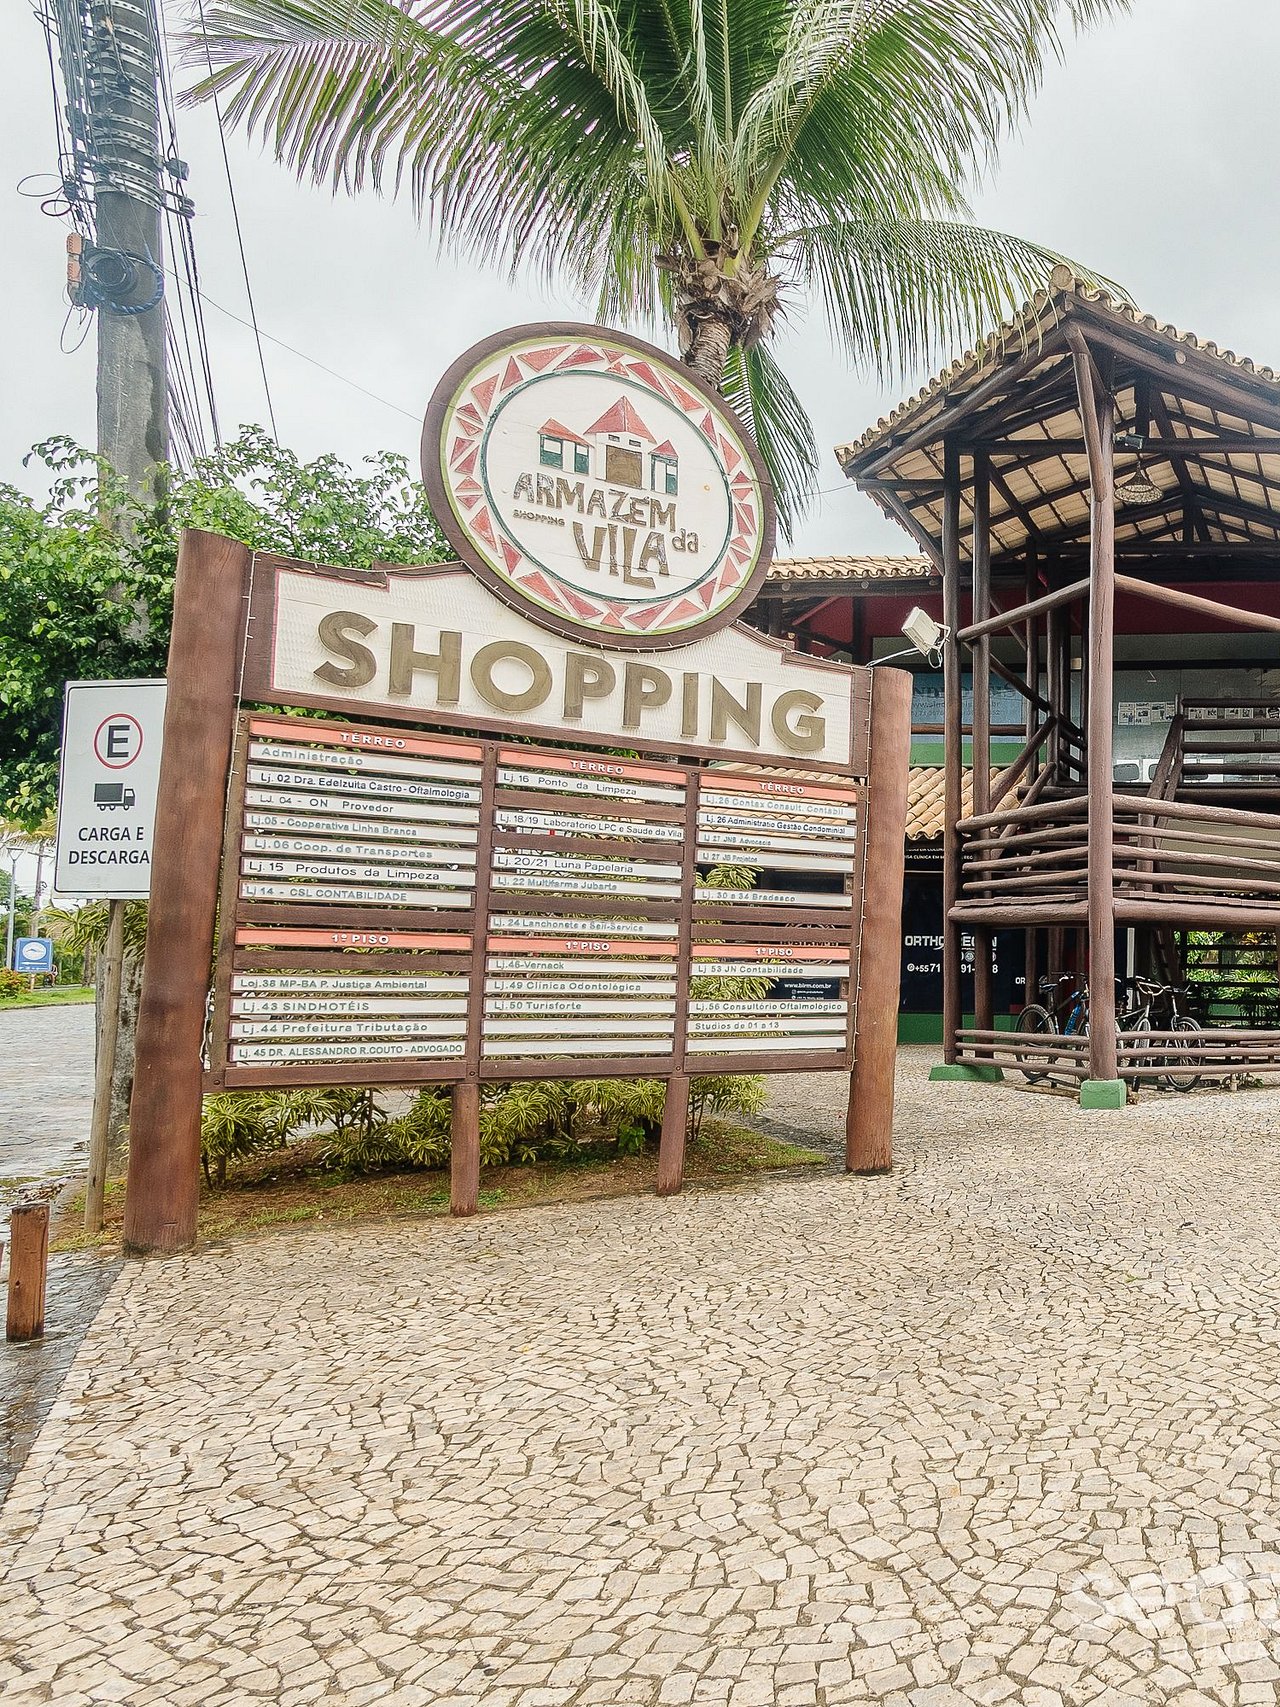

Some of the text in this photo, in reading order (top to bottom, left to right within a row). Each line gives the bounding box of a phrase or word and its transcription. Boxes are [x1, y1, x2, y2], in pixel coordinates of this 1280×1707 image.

[513, 509, 565, 527] SHOPPING
[672, 528, 699, 553] da
[573, 521, 670, 589] VILA
[313, 610, 826, 753] SHOPPING
[107, 724, 130, 758] E
[341, 731, 406, 748] TÉRREO
[261, 747, 363, 767] Administração
[261, 773, 273, 784] Lj.
[277, 774, 290, 784] 02
[294, 775, 316, 786] Dra.
[503, 773, 517, 784] Lj.
[538, 776, 568, 788] Ponto
[576, 781, 589, 790] da
[596, 784, 637, 796] Limpeza
[279, 796, 292, 805] 04
[310, 798, 328, 808] ON
[342, 801, 394, 814] Provedor
[287, 818, 349, 832] Cooperativa
[353, 823, 379, 834] Linha
[382, 826, 417, 836] Branca
[500, 814, 512, 824] Lj.
[514, 815, 539, 825] 18/19
[599, 822, 617, 832] LPC
[655, 828, 666, 837] da
[667, 829, 683, 839] Vila
[717, 816, 727, 824] 26
[803, 824, 846, 835] Condominial
[78, 827, 144, 842] CARGA E
[68, 851, 150, 865] DESCARGA
[293, 841, 332, 853] Coop.
[336, 844, 352, 854] de
[356, 845, 433, 860] Transportes
[249, 861, 440, 882] Lj. 15 Produtos da Limpeza
[497, 855, 634, 874] Lj. 20/21 Luna Papelaria
[527, 879, 579, 890] Multifarma
[261, 887, 274, 896] 14
[290, 888, 313, 898] CSL
[316, 889, 408, 902] CONTABILIDADE
[752, 893, 796, 902] Bradesco
[508, 919, 520, 927] 24
[522, 919, 579, 930] Lanchonete
[351, 934, 390, 945] PISO
[581, 941, 610, 951] PISO
[768, 948, 793, 957] PISO
[711, 966, 722, 974] 53
[724, 966, 736, 974] JN
[739, 966, 804, 975] Contabilidade
[279, 979, 317, 989] MP-BA
[320, 980, 329, 989] P.
[332, 980, 372, 991] Justiça
[374, 980, 427, 989] Ambiental
[282, 1001, 370, 1012] SINDHOTÉIS
[526, 1001, 582, 1010] Turisforte
[282, 1023, 352, 1033] Prefeitura
[356, 1022, 428, 1034] Tributação
[695, 1022, 731, 1031] Studios
[734, 1022, 745, 1030] de
[239, 1048, 251, 1059] Lj.
[254, 1048, 266, 1057] 45
[268, 1046, 286, 1057] DR.
[289, 1045, 357, 1057] ALESSANDRO
[411, 1043, 462, 1054] ADVOGADO
